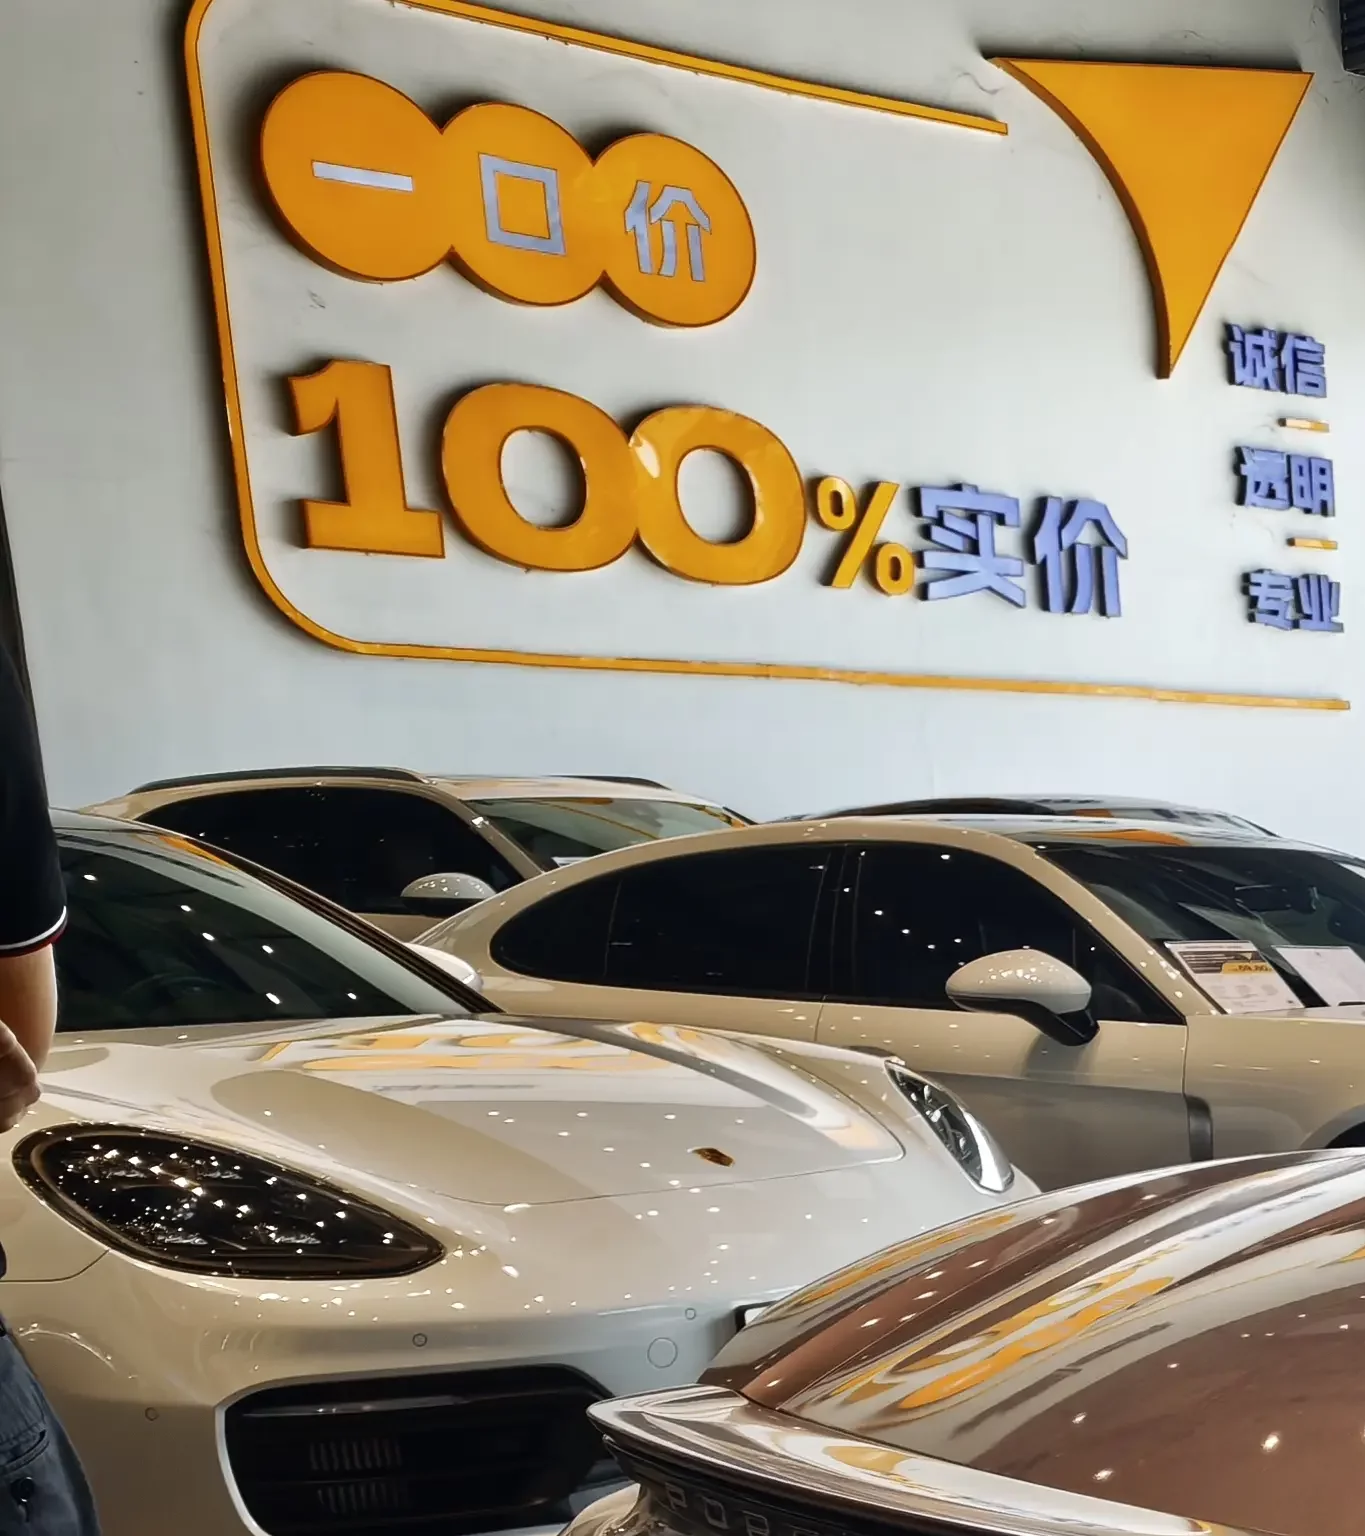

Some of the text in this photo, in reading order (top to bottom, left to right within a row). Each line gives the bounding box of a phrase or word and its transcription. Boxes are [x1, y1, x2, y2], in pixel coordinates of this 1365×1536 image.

[311, 152, 711, 283] 一口价
[1225, 324, 1327, 398] 诚信
[1234, 446, 1335, 517] 透明
[1242, 568, 1344, 633] 专业
